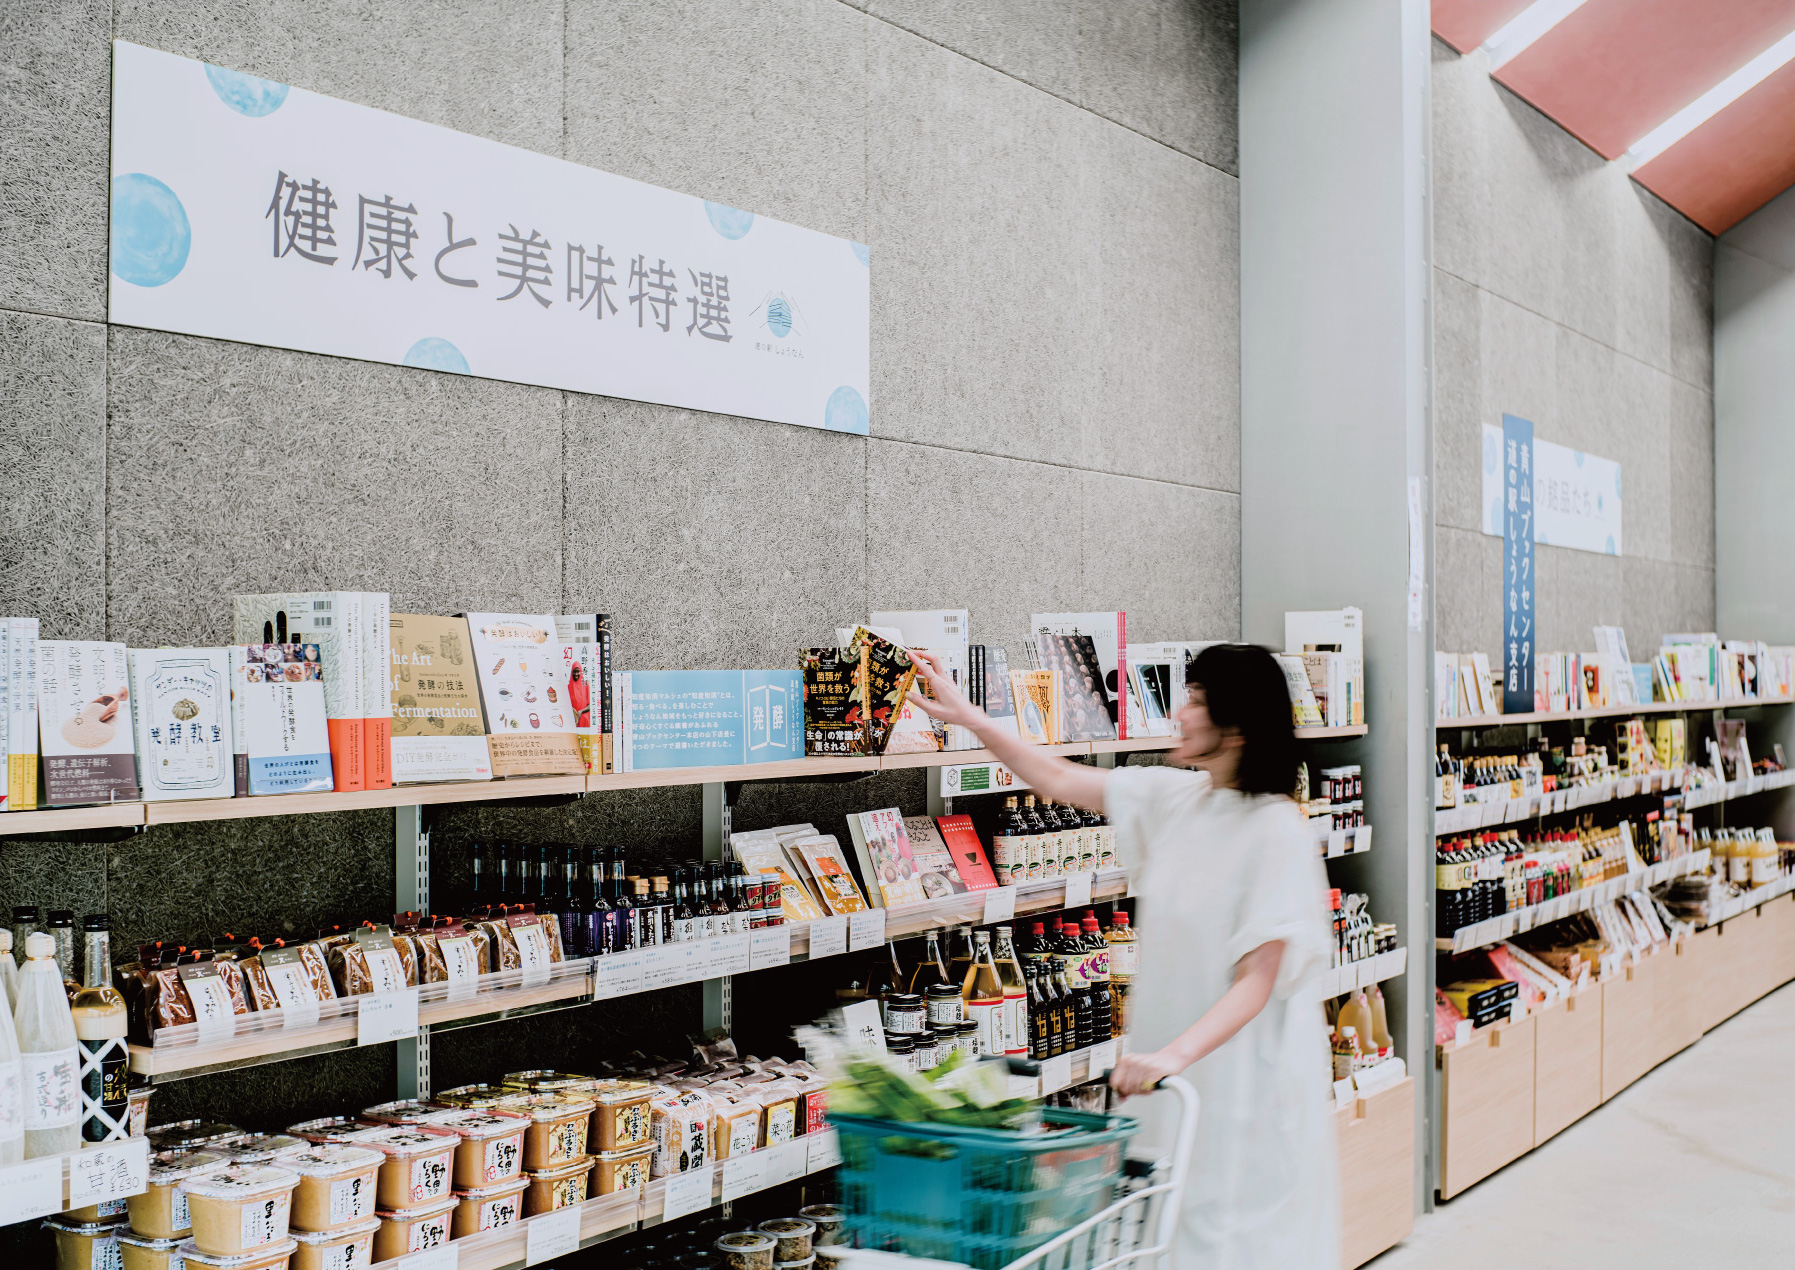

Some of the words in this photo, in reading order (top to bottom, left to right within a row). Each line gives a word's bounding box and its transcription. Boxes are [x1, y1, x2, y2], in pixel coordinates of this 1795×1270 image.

[264, 169, 734, 344] 健康と美味特選
[1507, 438, 1519, 693] 道の駅しょうなん支店
[1520, 443, 1530, 692] 青山ブックセンター
[390, 648, 409, 665] he
[411, 651, 432, 666] Art
[40, 646, 58, 694] 菌の話
[816, 671, 843, 682] 菌類が
[417, 679, 464, 691] 発酵の技法
[810, 683, 850, 694] 世界を救う
[390, 702, 478, 718] Fermentation
[753, 704, 784, 731] 発酵
[151, 723, 221, 744] 発酵教室
[632, 730, 736, 740] 青山ブックセンター本店の山下店長に
[815, 741, 850, 752] 覆される!
[771, 1118, 793, 1138] 菜の花
[733, 1132, 756, 1151] 花こうじ
